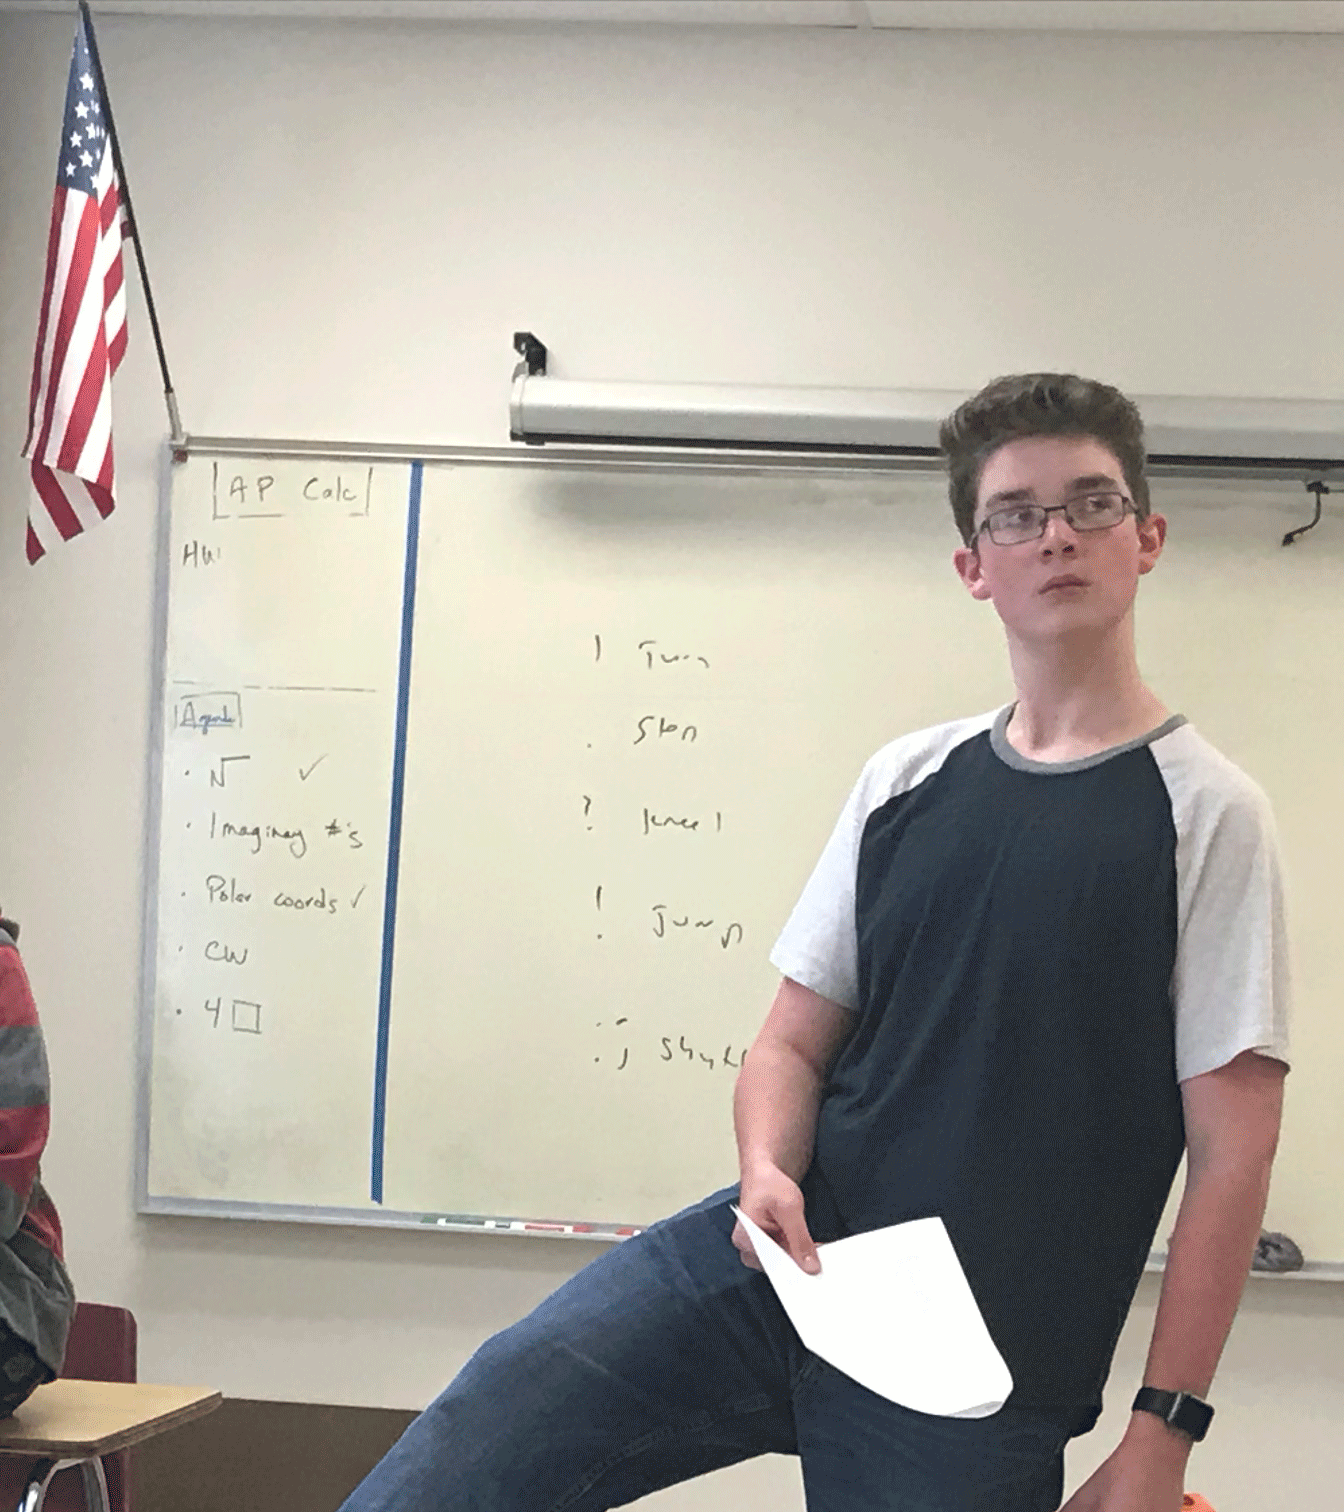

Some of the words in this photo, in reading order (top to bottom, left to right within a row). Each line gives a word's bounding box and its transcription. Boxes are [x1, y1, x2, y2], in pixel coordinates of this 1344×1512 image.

[229, 475, 275, 502] AP
[302, 476, 358, 502] Calc
[205, 874, 253, 904] Polar
[272, 887, 338, 915] coords
